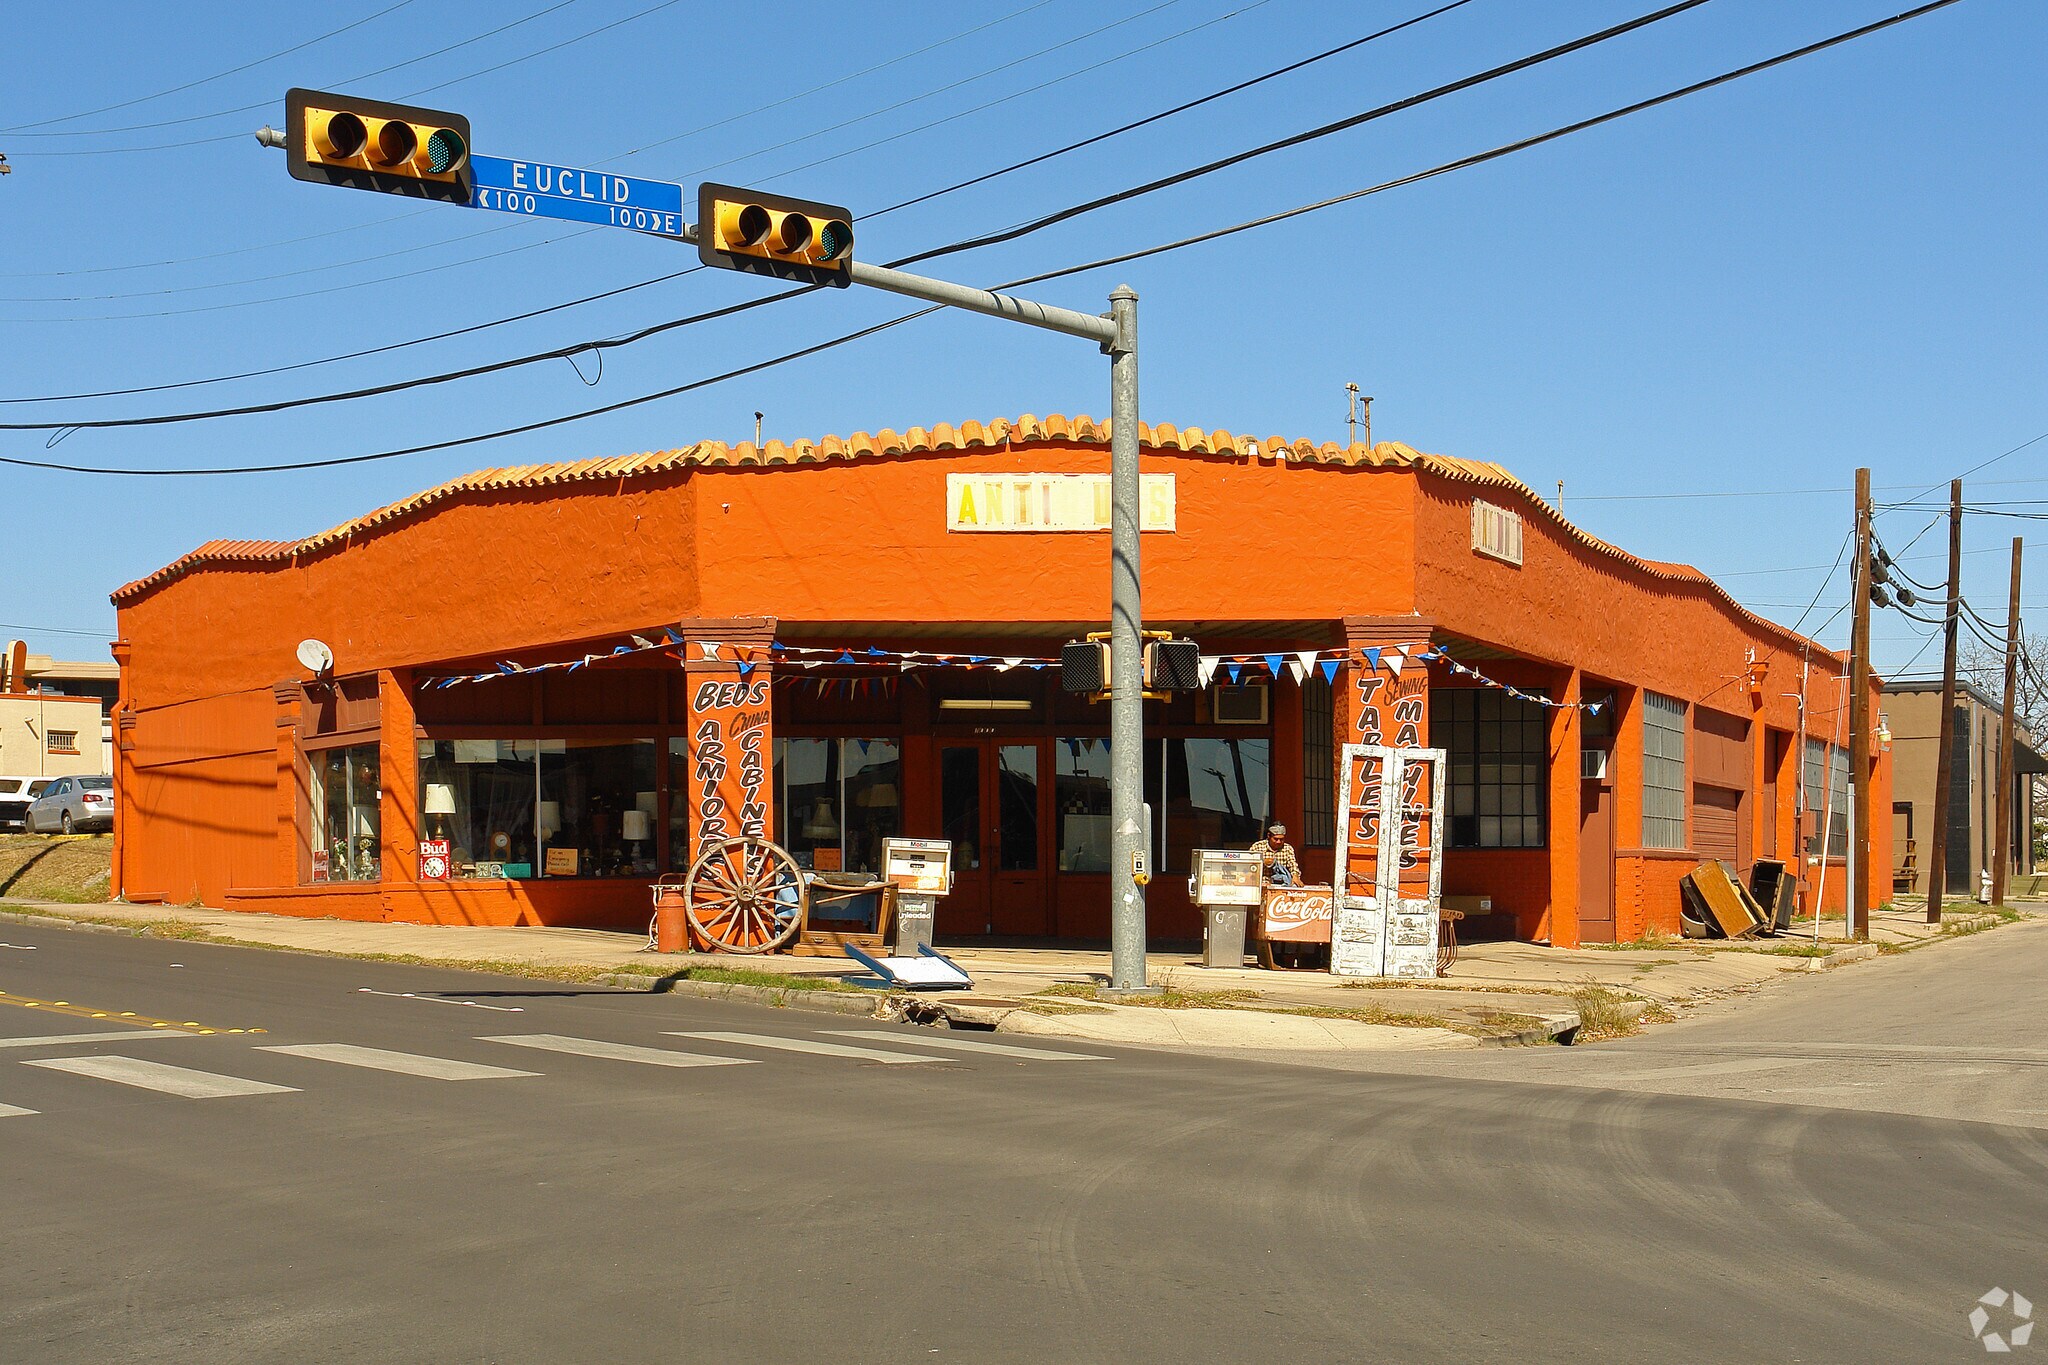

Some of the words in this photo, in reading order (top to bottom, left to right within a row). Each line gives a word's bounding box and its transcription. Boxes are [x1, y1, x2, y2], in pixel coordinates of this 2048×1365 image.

[513, 163, 629, 202] EUCLID
[496, 191, 536, 213] 100
[609, 207, 647, 229] 100
[665, 215, 675, 233] E
[693, 680, 770, 713] BEDS
[1383, 676, 1428, 706] SEWING
[728, 710, 770, 738] CHINA
[420, 841, 448, 855] Bud
[1268, 895, 1333, 920] Coca-Cola
